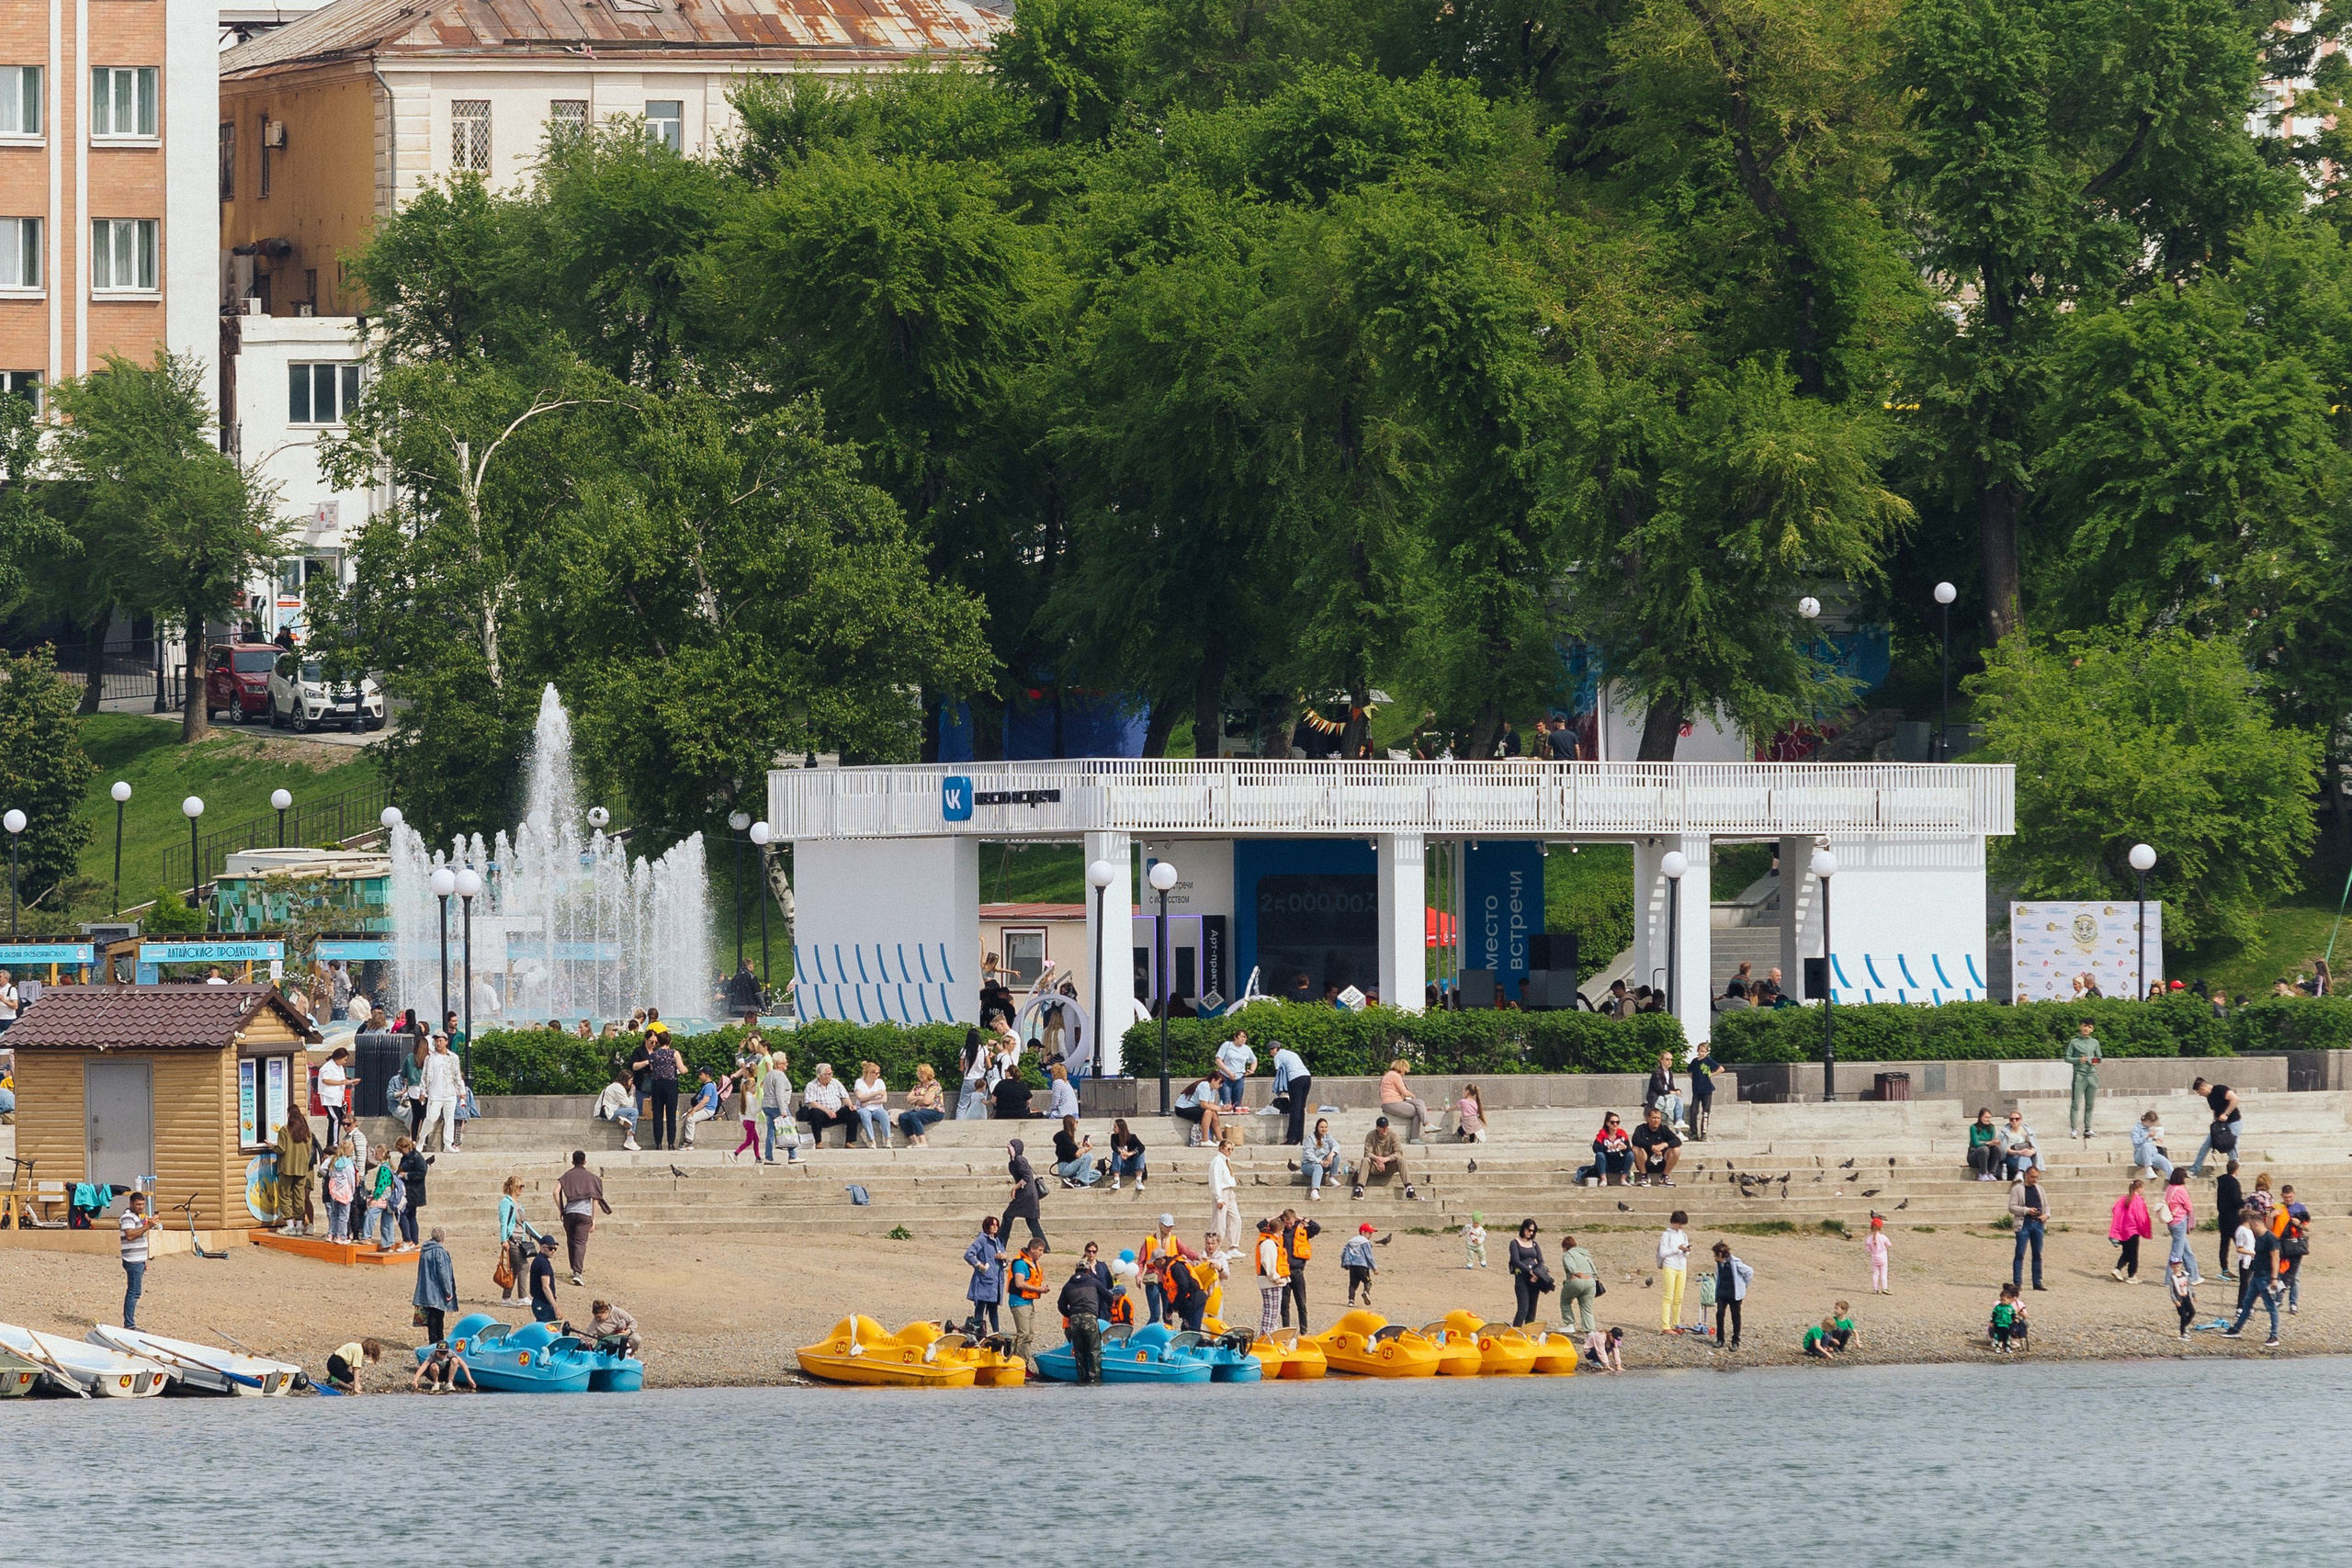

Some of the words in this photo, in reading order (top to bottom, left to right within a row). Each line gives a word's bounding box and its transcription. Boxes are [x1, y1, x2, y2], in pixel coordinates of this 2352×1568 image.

[945, 789, 961, 810] VK
[1510, 871, 1528, 970] встречи
[1486, 895, 1498, 970] место
[217, 945, 258, 957] ПРОДУКТЫ
[456, 1342, 466, 1350] 34
[836, 1344, 845, 1352] 30
[1483, 1339, 1488, 1348] 6
[903, 1353, 913, 1361] 30
[1384, 1349, 1393, 1358] 15
[519, 1355, 528, 1363] 34
[22, 1373, 28, 1382] 5
[120, 1374, 130, 1386] 4
[154, 1374, 161, 1382] 4
[280, 1374, 288, 1386] 2
